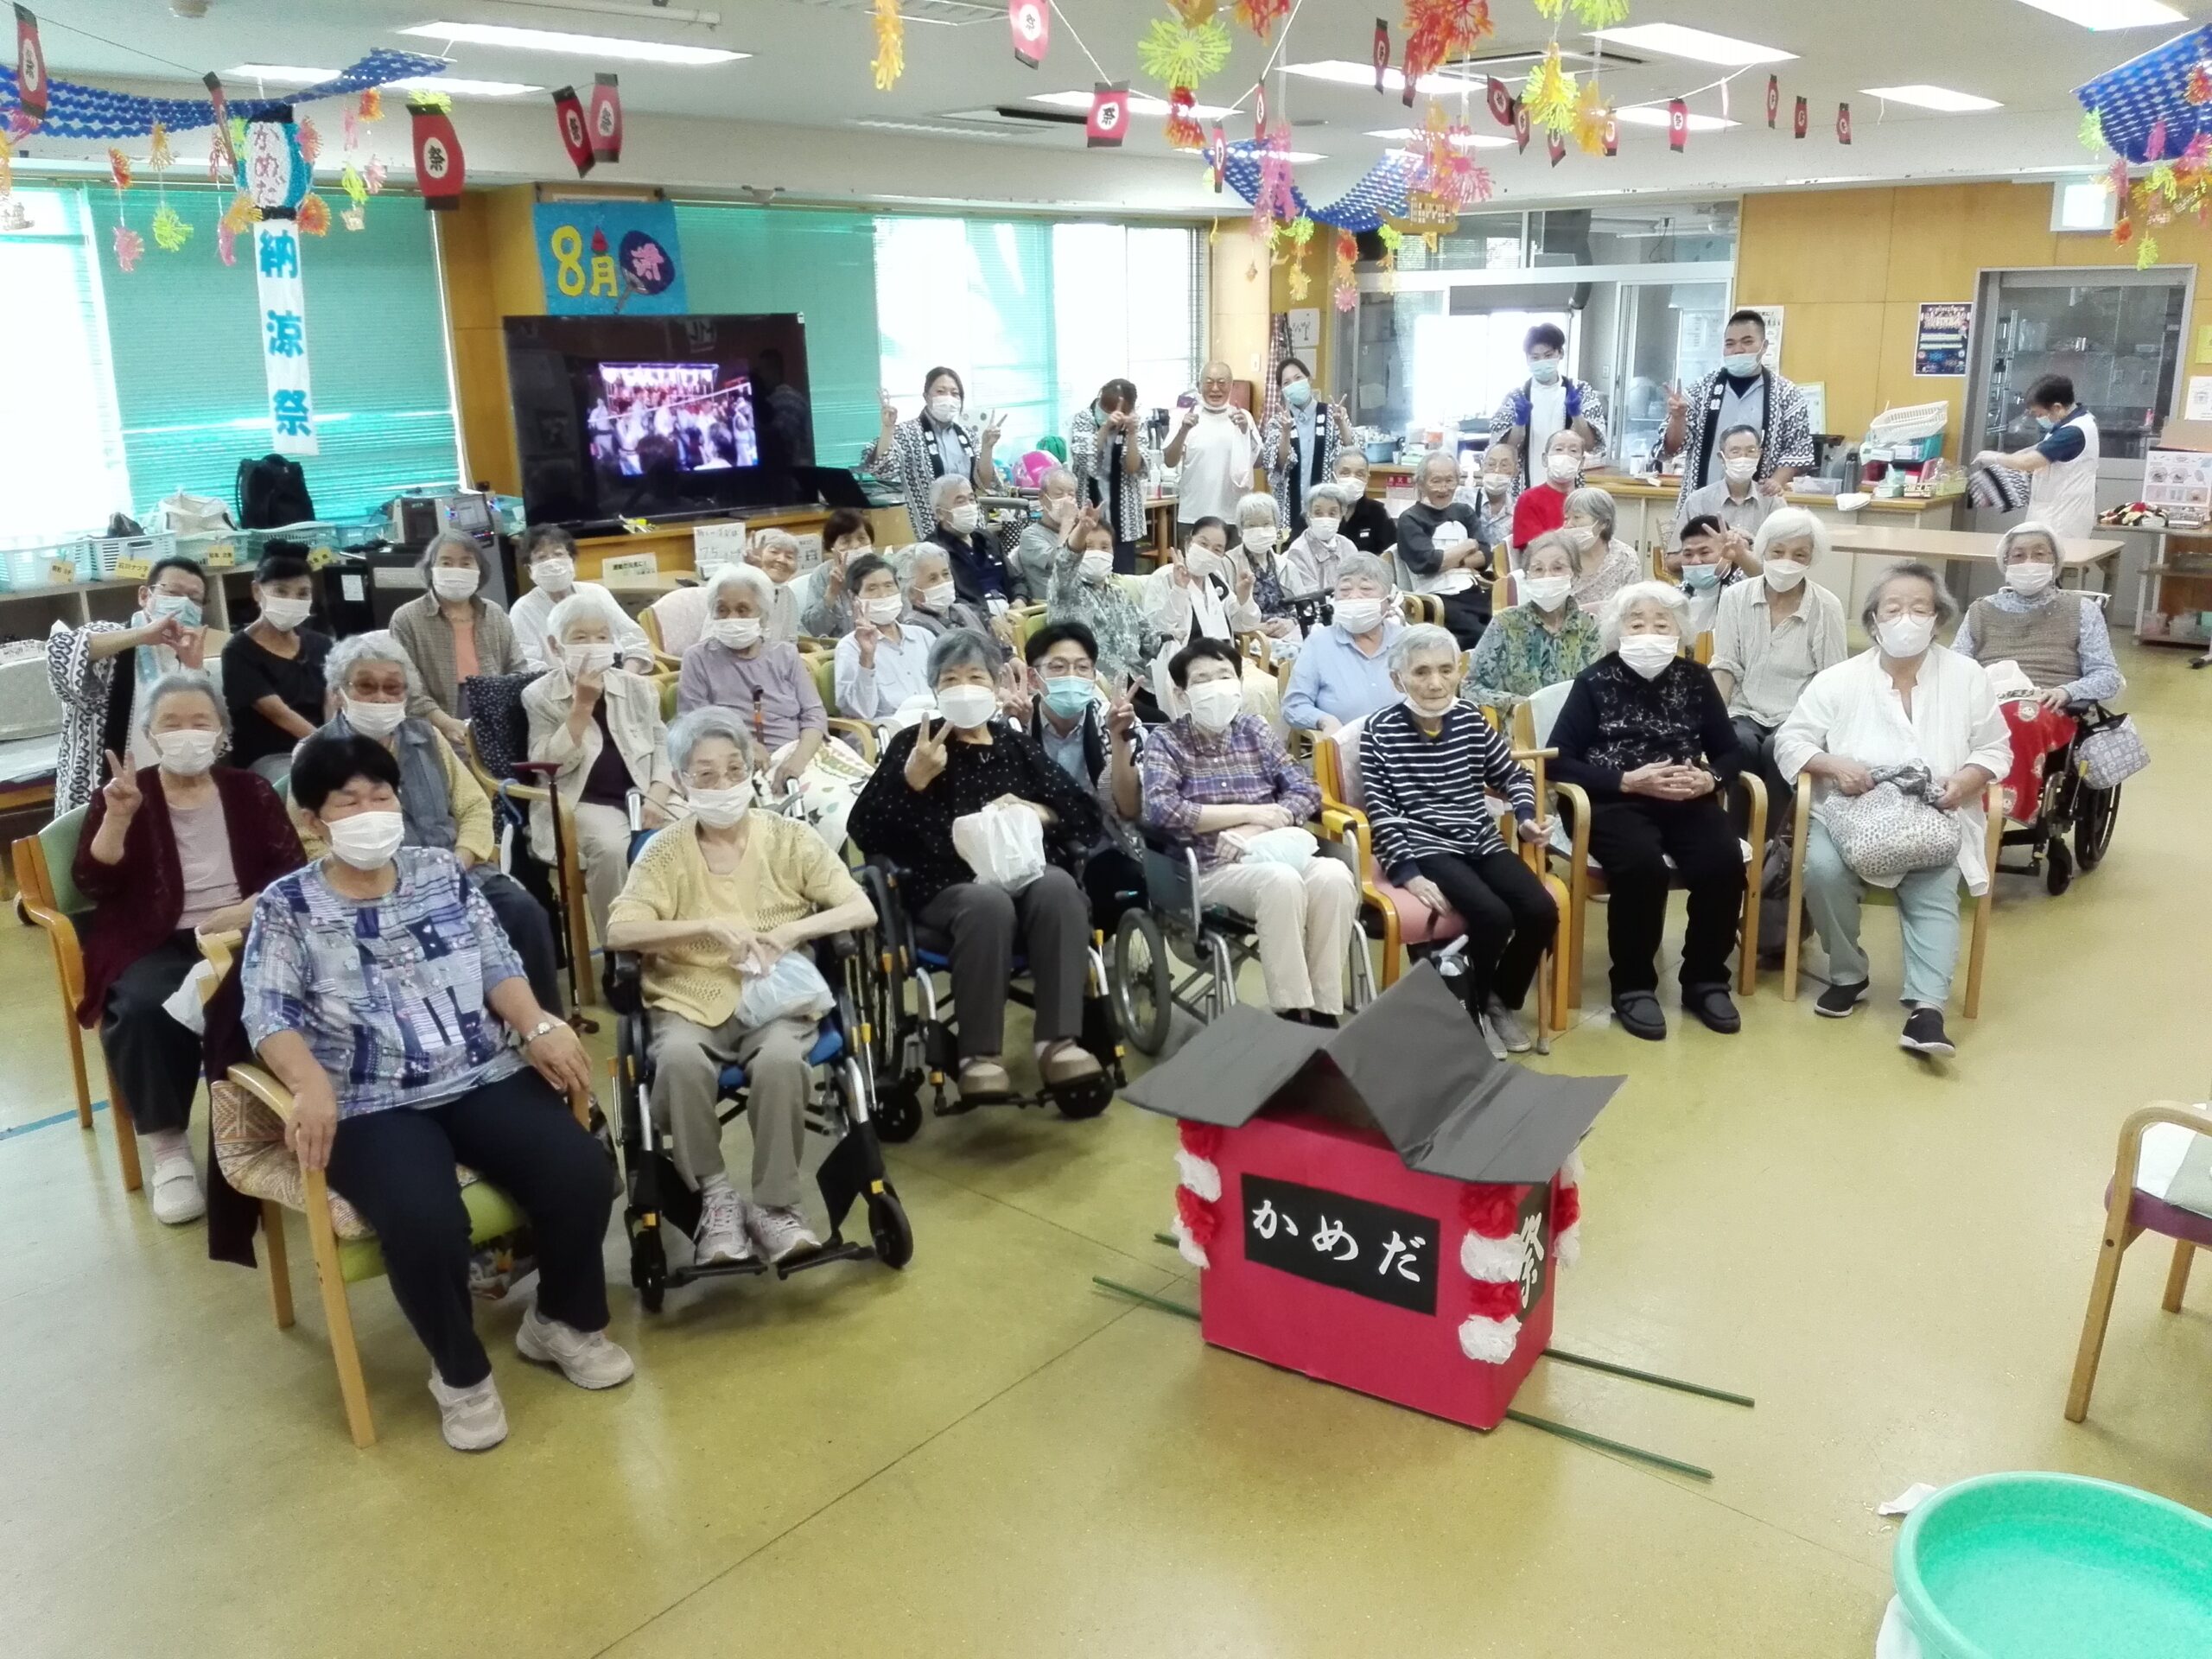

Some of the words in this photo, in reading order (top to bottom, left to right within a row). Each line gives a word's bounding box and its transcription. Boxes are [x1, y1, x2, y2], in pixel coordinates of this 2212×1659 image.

[1102, 105, 1116, 125] 祭
[254, 123, 286, 205] かめだ
[428, 143, 446, 172] 祭
[551, 225, 618, 297] 8月
[259, 228, 313, 437] 納涼祭
[1252, 1198, 1427, 1283] かめだ
[1518, 1211, 1545, 1310] 祭
